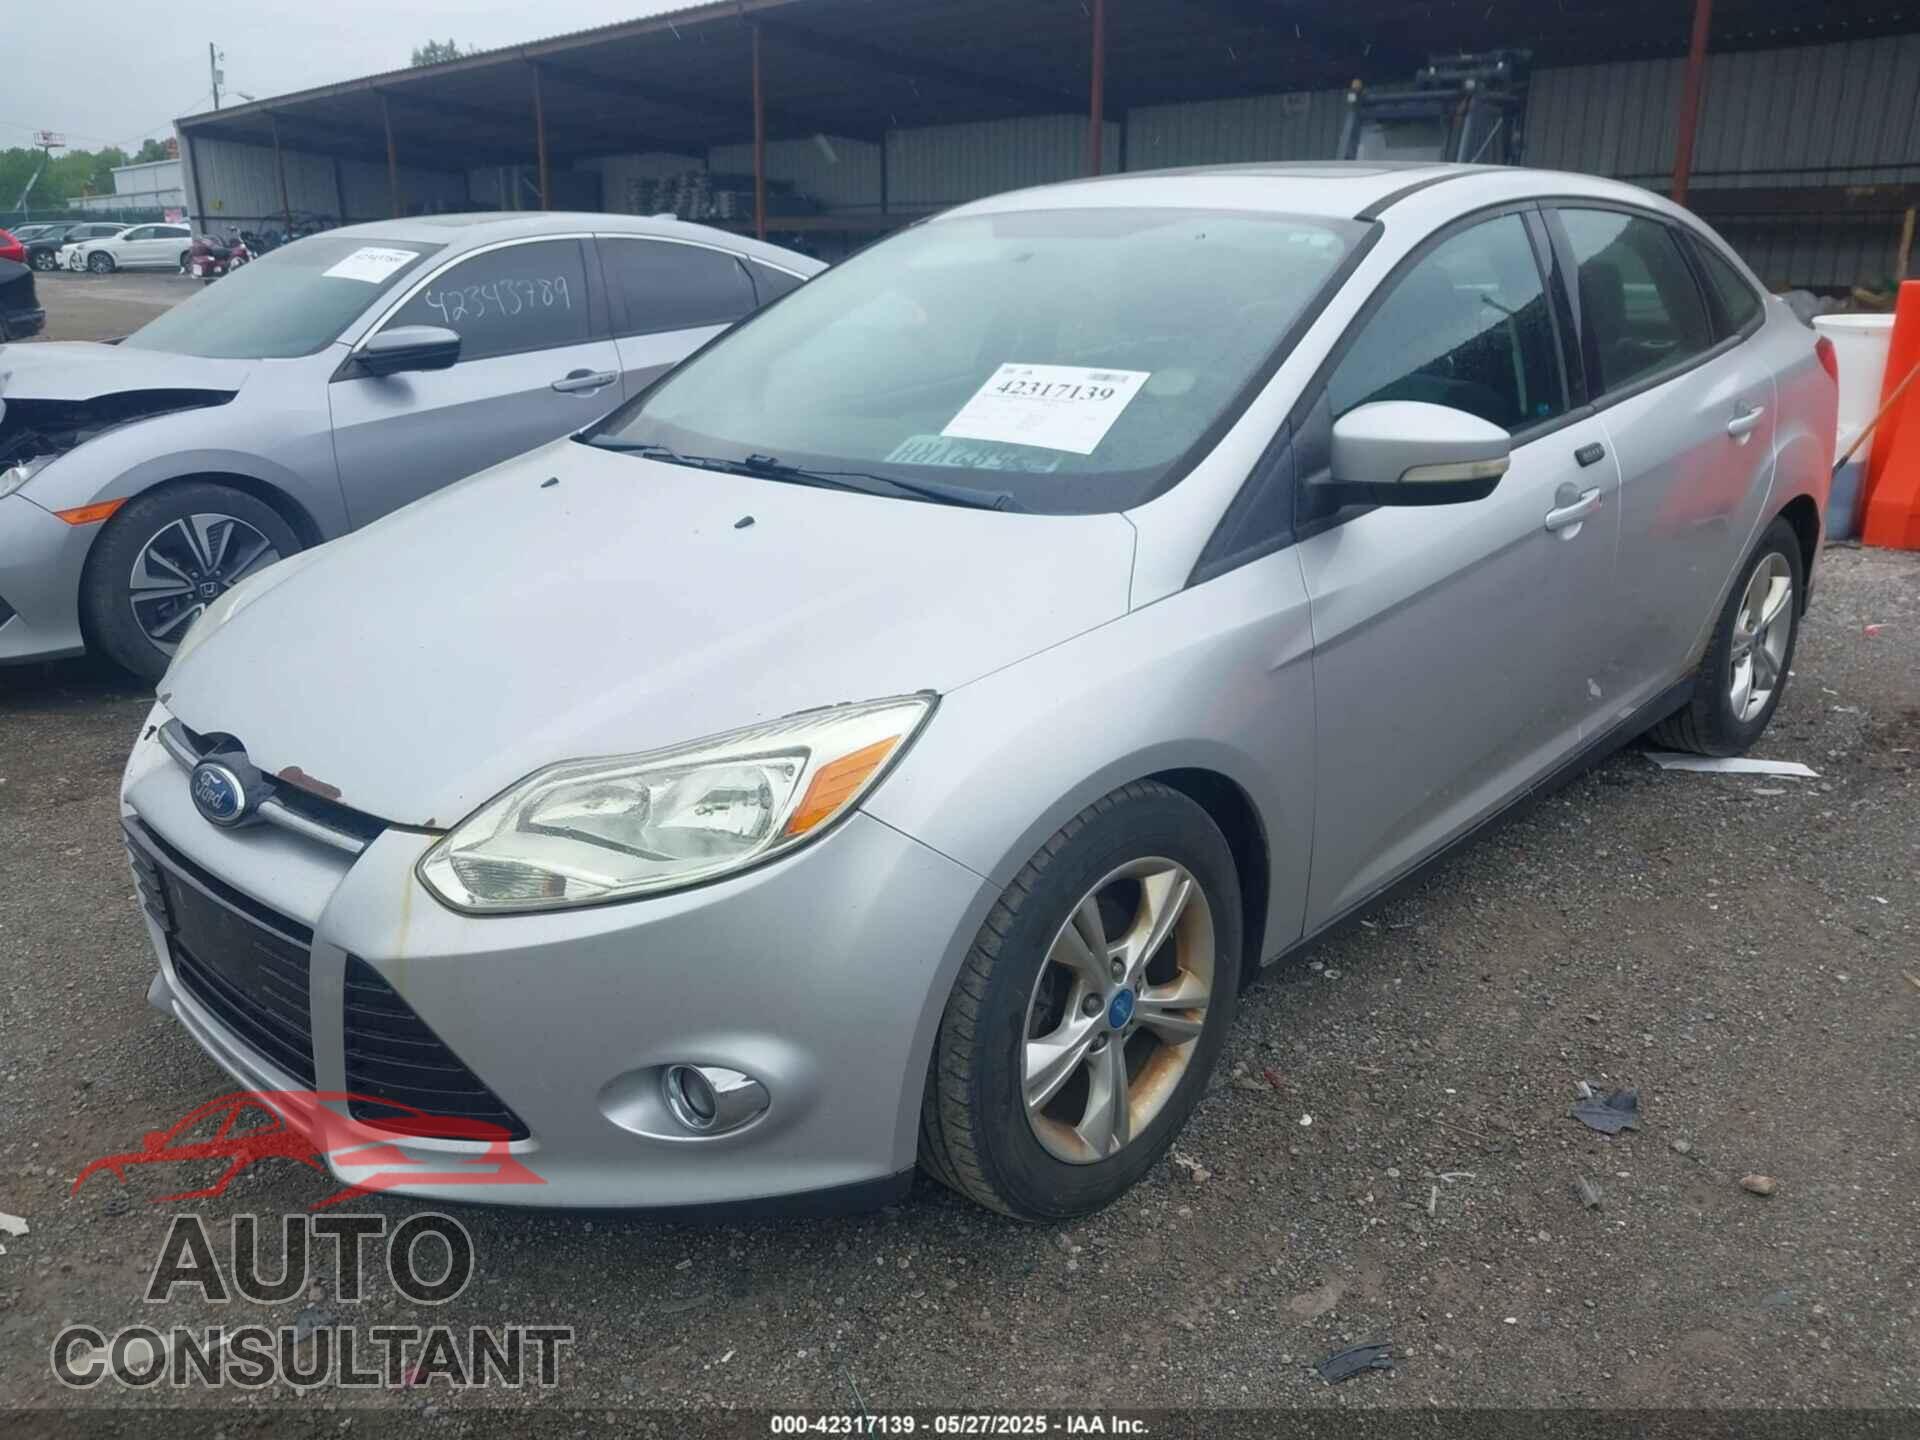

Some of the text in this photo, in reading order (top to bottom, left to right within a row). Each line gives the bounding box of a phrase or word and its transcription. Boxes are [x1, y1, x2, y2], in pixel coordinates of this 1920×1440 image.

[425, 276, 570, 323] 42343789
[997, 380, 1115, 400] 42317139
[195, 770, 226, 809] Ford
